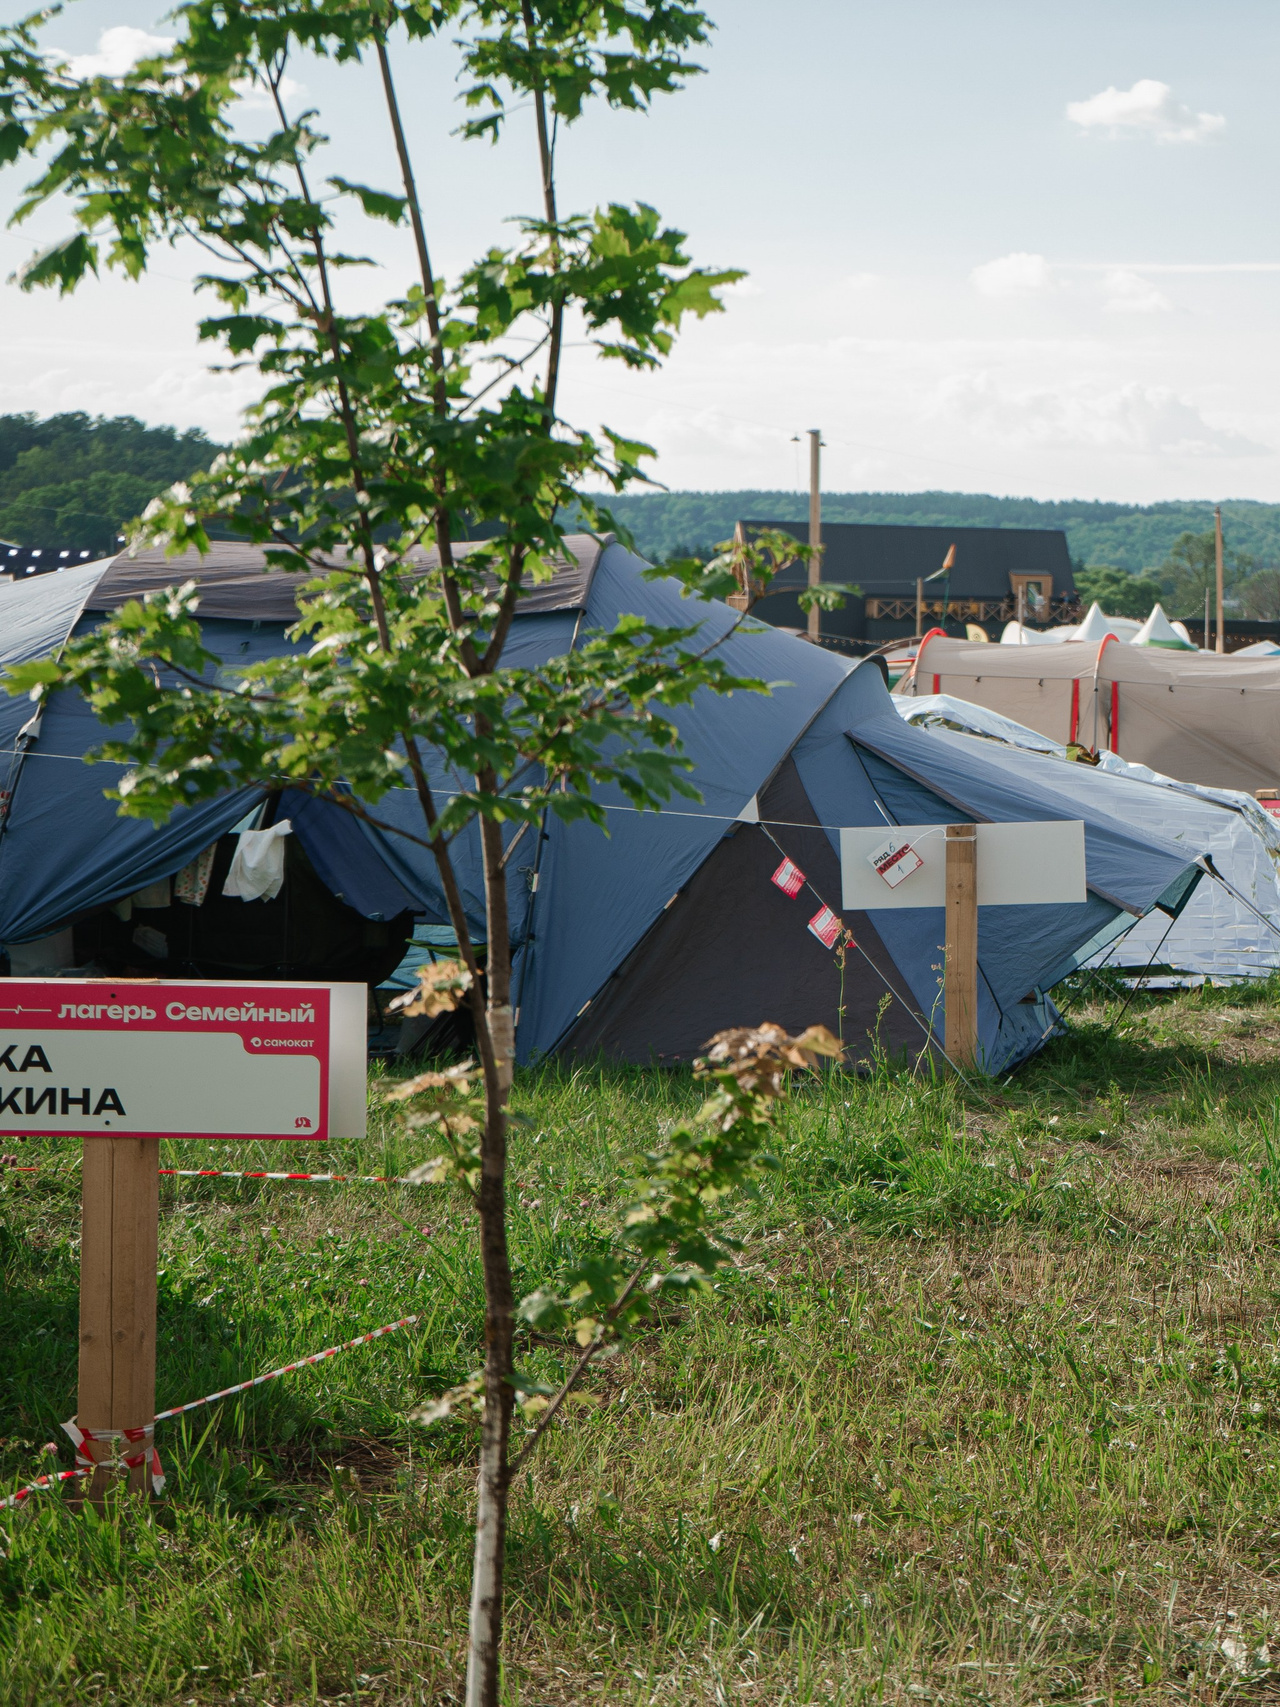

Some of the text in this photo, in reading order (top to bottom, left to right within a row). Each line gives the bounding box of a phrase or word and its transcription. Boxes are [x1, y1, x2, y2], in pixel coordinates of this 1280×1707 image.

[873, 851, 891, 866] РЯД
[57, 1001, 315, 1023] лагерь Семейный
[263, 1038, 315, 1048] самокат
